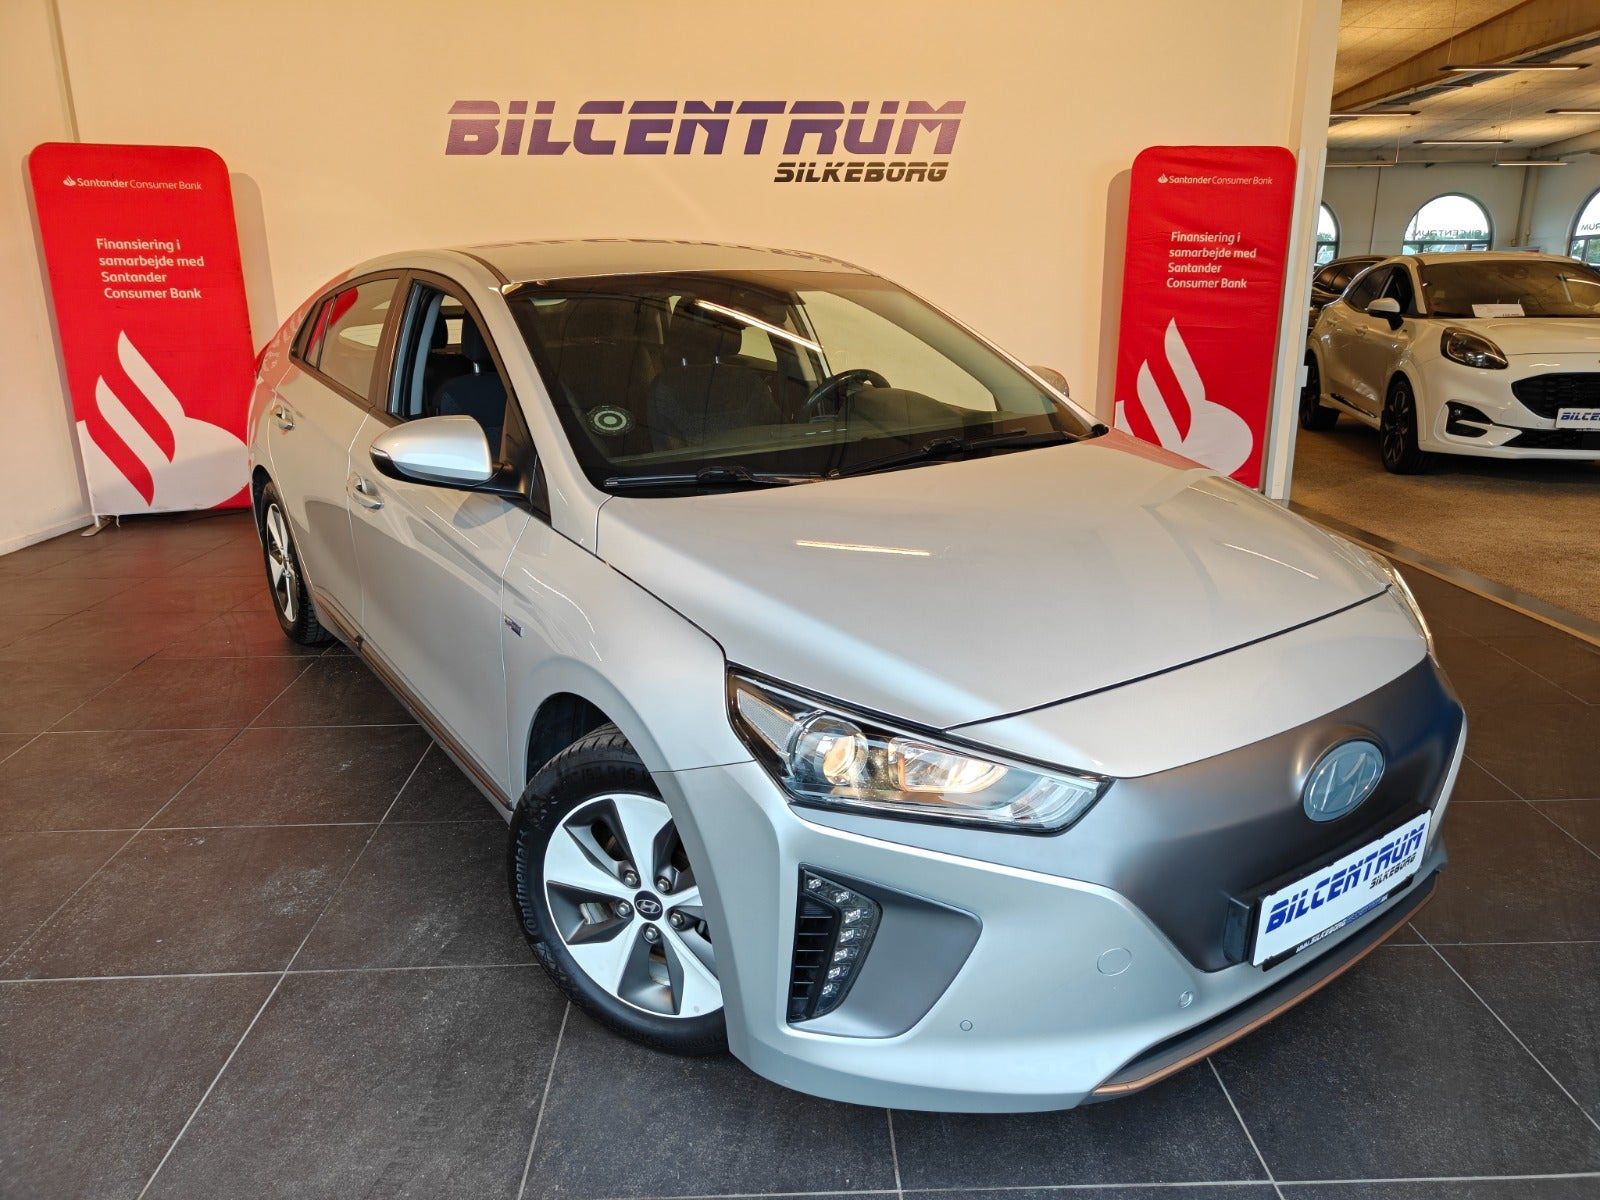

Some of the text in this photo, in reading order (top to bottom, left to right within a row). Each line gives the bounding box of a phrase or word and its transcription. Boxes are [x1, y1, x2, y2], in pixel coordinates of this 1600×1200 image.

[444, 99, 967, 156] BILCENTRUM
[773, 161, 949, 183] SILKEBORG
[77, 177, 202, 190] Santander Consumer Bank
[1168, 175, 1273, 185] Santander Consumer Bank
[1171, 231, 1241, 244] Finansiering i
[96, 237, 181, 252] Finansiering i
[1169, 248, 1257, 260] samarbejde med
[99, 255, 205, 268] samarbejde med
[1168, 262, 1222, 273] Santander
[101, 271, 167, 283] Santander
[1166, 278, 1247, 288] Consumer Bank
[104, 287, 202, 299] Consumer Bank
[1561, 412, 1600, 420] BILCE
[1369, 853, 1416, 889] SILKEBORG
[1265, 822, 1426, 934] BILCENTRUM
